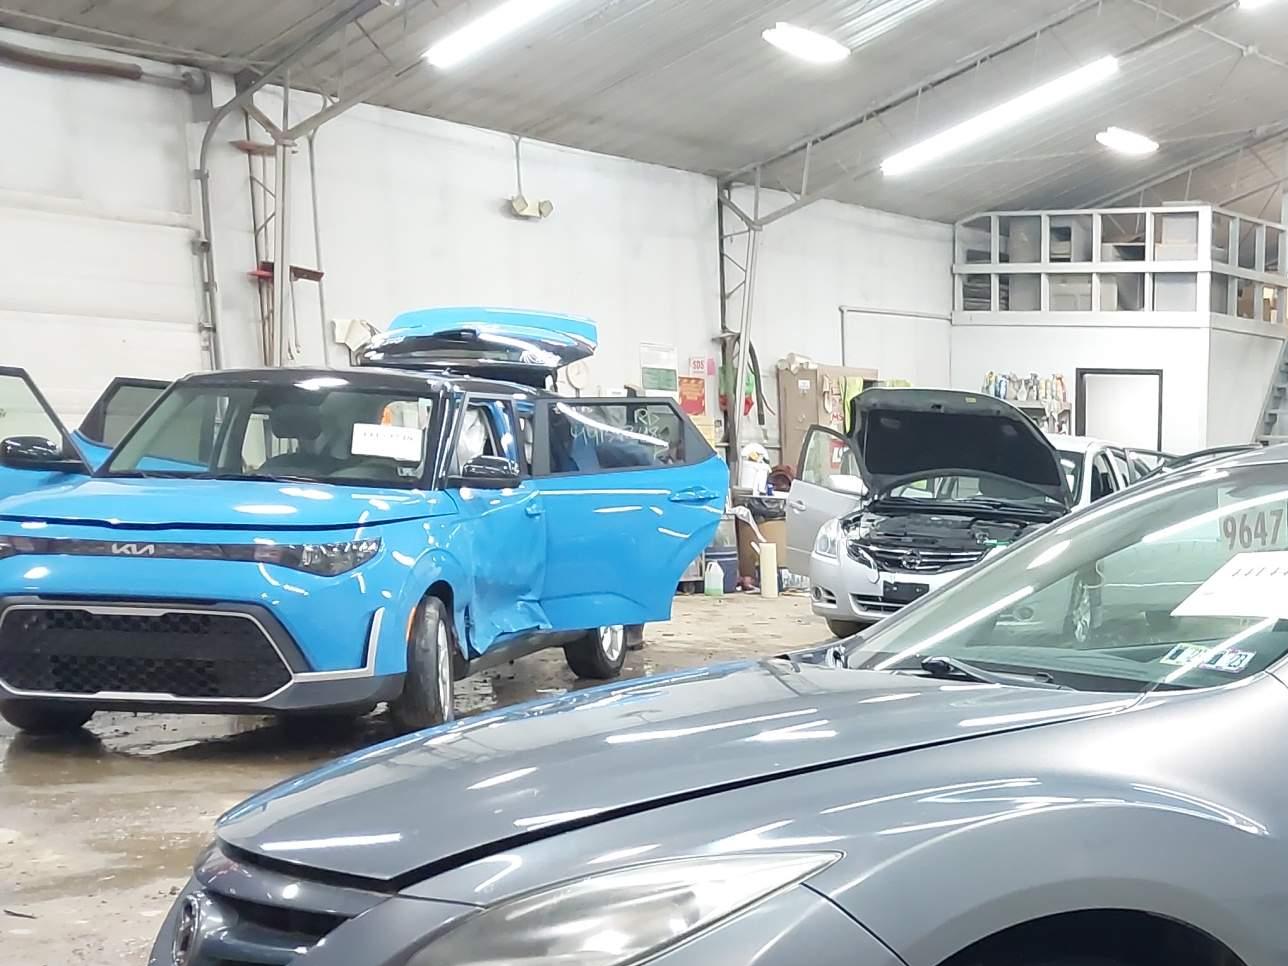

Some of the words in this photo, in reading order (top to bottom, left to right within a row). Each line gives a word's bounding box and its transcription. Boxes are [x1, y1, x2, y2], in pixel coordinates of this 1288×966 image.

[692, 360, 704, 370] SDS
[1222, 508, 1284, 550] 9647
[111, 543, 155, 554] KIA
